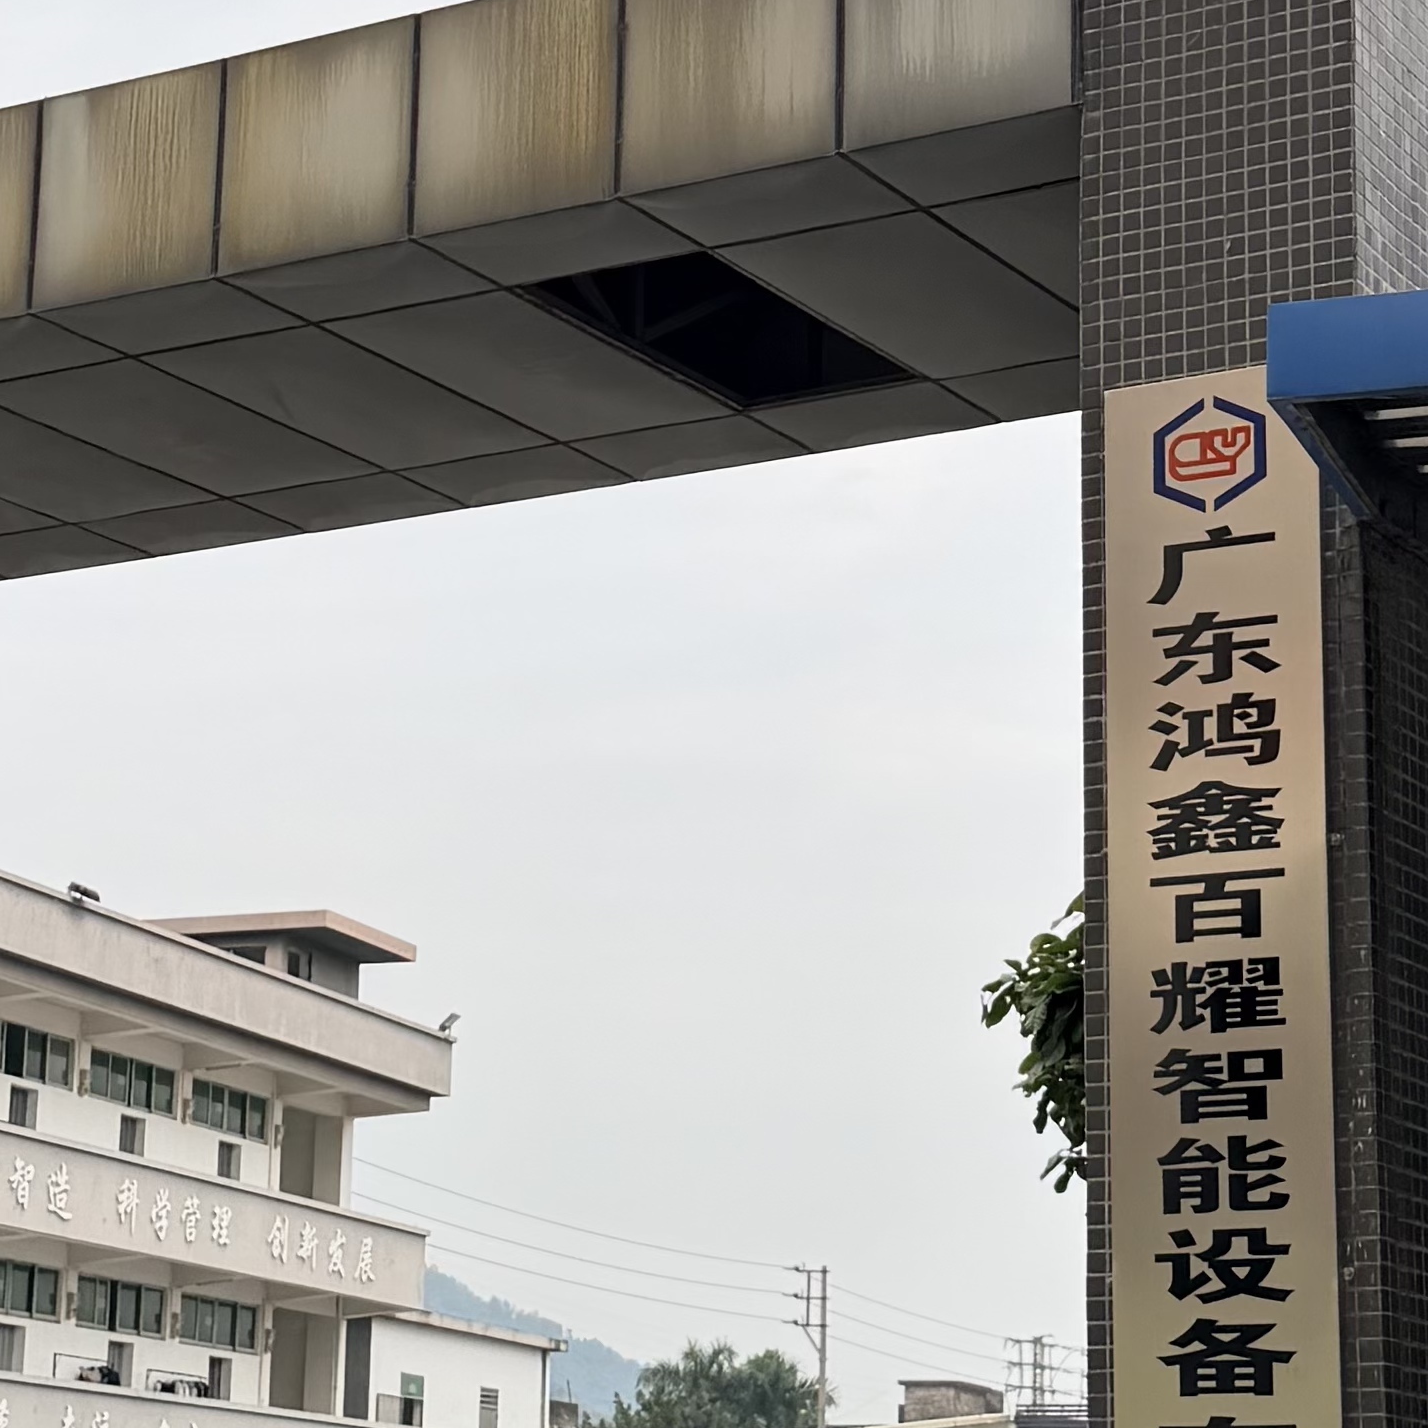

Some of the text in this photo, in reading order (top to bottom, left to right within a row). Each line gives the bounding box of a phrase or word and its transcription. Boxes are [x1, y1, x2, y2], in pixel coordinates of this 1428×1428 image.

[116, 1178, 233, 1246] 科学管理
[267, 1214, 376, 1283] 创新发展
